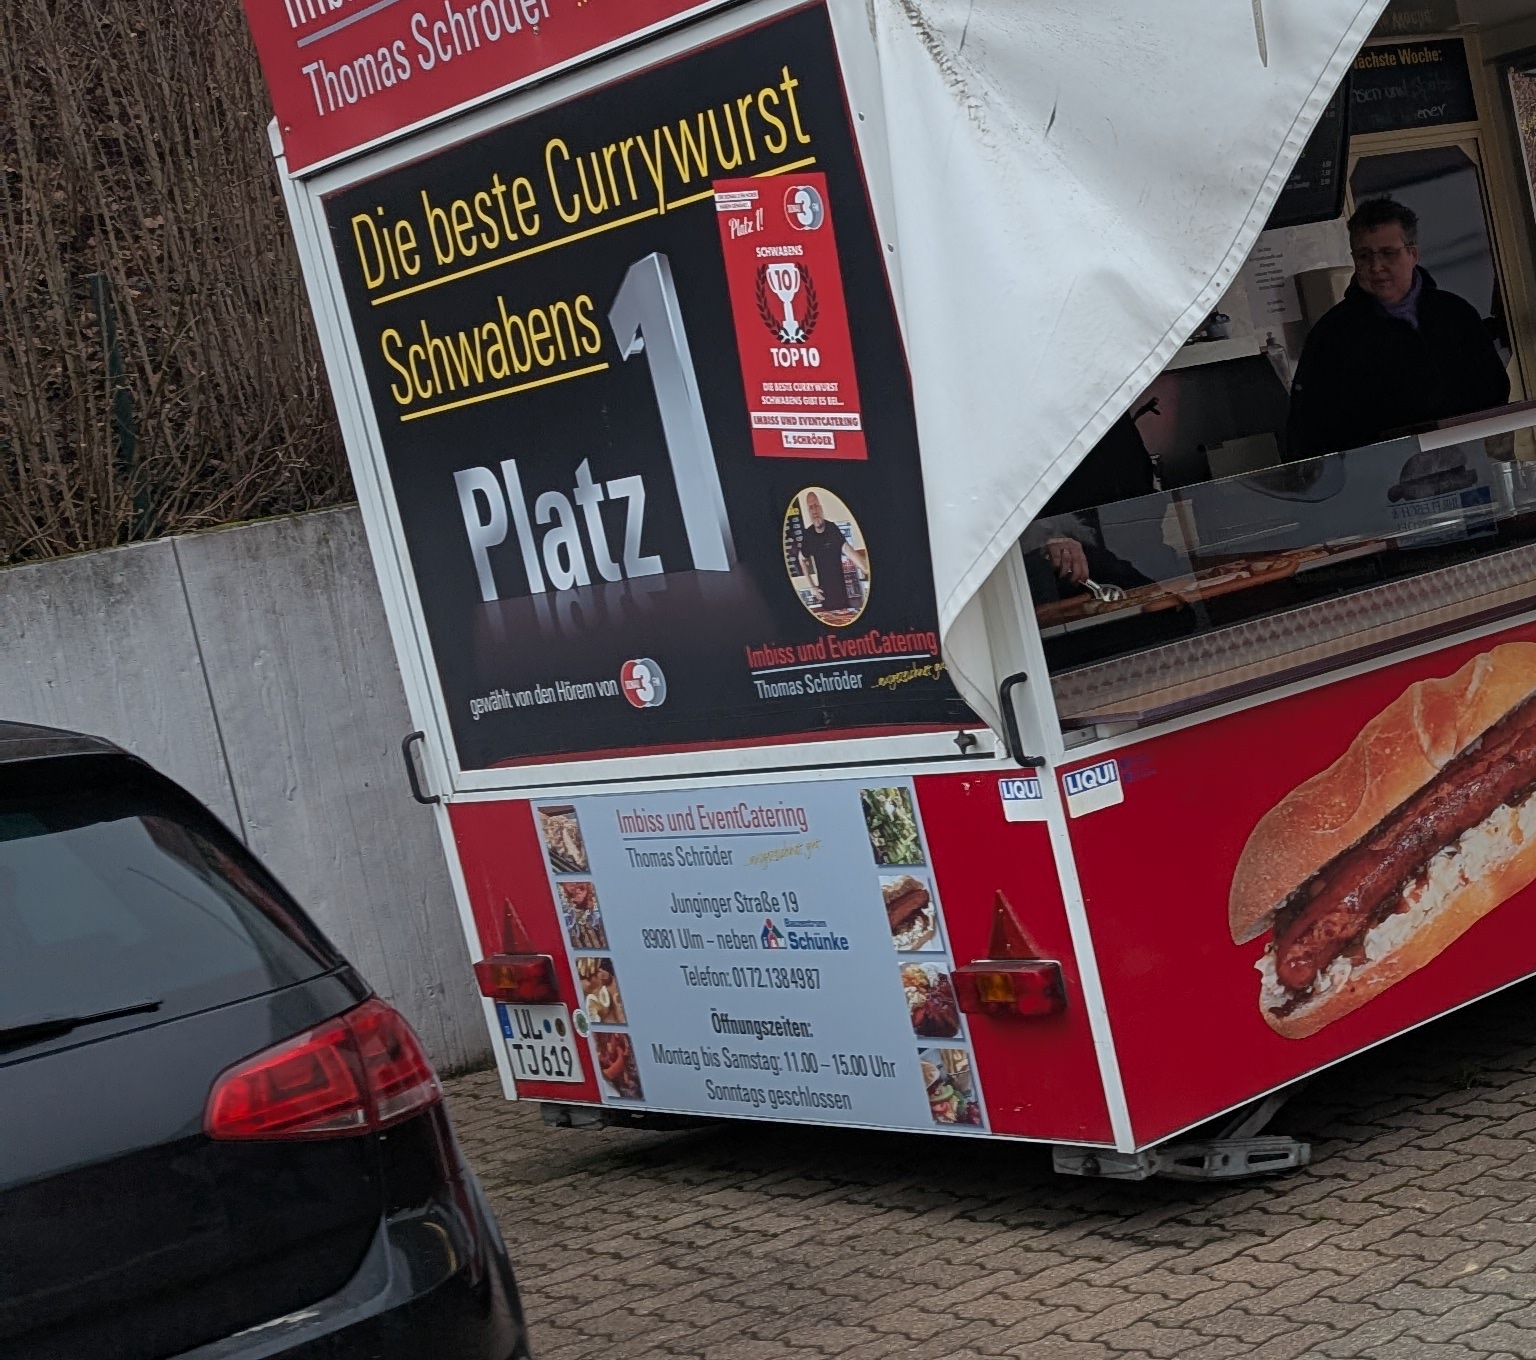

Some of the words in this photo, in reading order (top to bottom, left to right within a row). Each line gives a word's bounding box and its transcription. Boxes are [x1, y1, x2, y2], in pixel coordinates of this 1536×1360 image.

[1398, 47, 1443, 65] Woche:
[302, 33, 411, 117] Thomas
[351, 209, 419, 289] Die
[421, 172, 540, 265] beste
[544, 65, 810, 215] Currywurst
[728, 216, 754, 240] Platz
[755, 207, 764, 232] 1!
[795, 191, 814, 225] 3
[756, 245, 803, 257] SCHWABENS
[775, 269, 792, 291] 10
[381, 292, 603, 406] Schwabens
[452, 457, 665, 602] Platz
[608, 252, 738, 572] 1
[754, 416, 779, 425] IMBISS
[781, 416, 797, 425] UND
[799, 416, 859, 426] EVENTCATERING
[793, 433, 833, 445] SCHRÖDER
[746, 641, 795, 668] Imbiss
[797, 637, 826, 663] und
[828, 627, 939, 658] EventCatering
[631, 664, 655, 701] 3
[754, 677, 804, 700] Thomas
[804, 671, 863, 693] Schröder
[469, 688, 513, 721] gewählt
[512, 690, 534, 707] von
[535, 683, 557, 704] den
[597, 678, 619, 697] von
[1001, 780, 1041, 799] LIQUI
[1066, 763, 1116, 794] LIQUI
[616, 808, 665, 833] Imbiss
[666, 805, 696, 832] und
[696, 800, 808, 833] EventCatering
[625, 847, 675, 869] Thomas
[675, 844, 733, 867] Schröder
[670, 892, 732, 919] Junginger
[734, 890, 781, 913] Straße
[782, 891, 799, 913] 19
[641, 929, 677, 950] 89081
[677, 928, 705, 949] Ulm
[716, 928, 758, 950] neben
[788, 931, 849, 951] Schünke
[680, 965, 732, 987] Telefon:
[732, 966, 821, 990] 0172.1384987
[514, 1008, 543, 1040] UL
[710, 1007, 813, 1040] Öffnungszeiten:
[651, 1043, 701, 1070] Montag
[700, 1045, 721, 1067] bis
[721, 1046, 783, 1076] Samstag:
[784, 1051, 819, 1074] 11.00
[832, 1053, 869, 1077] 15.00
[869, 1055, 897, 1078] Uhr
[705, 1078, 767, 1109] Sonntags
[768, 1086, 853, 1111] geschlossen
